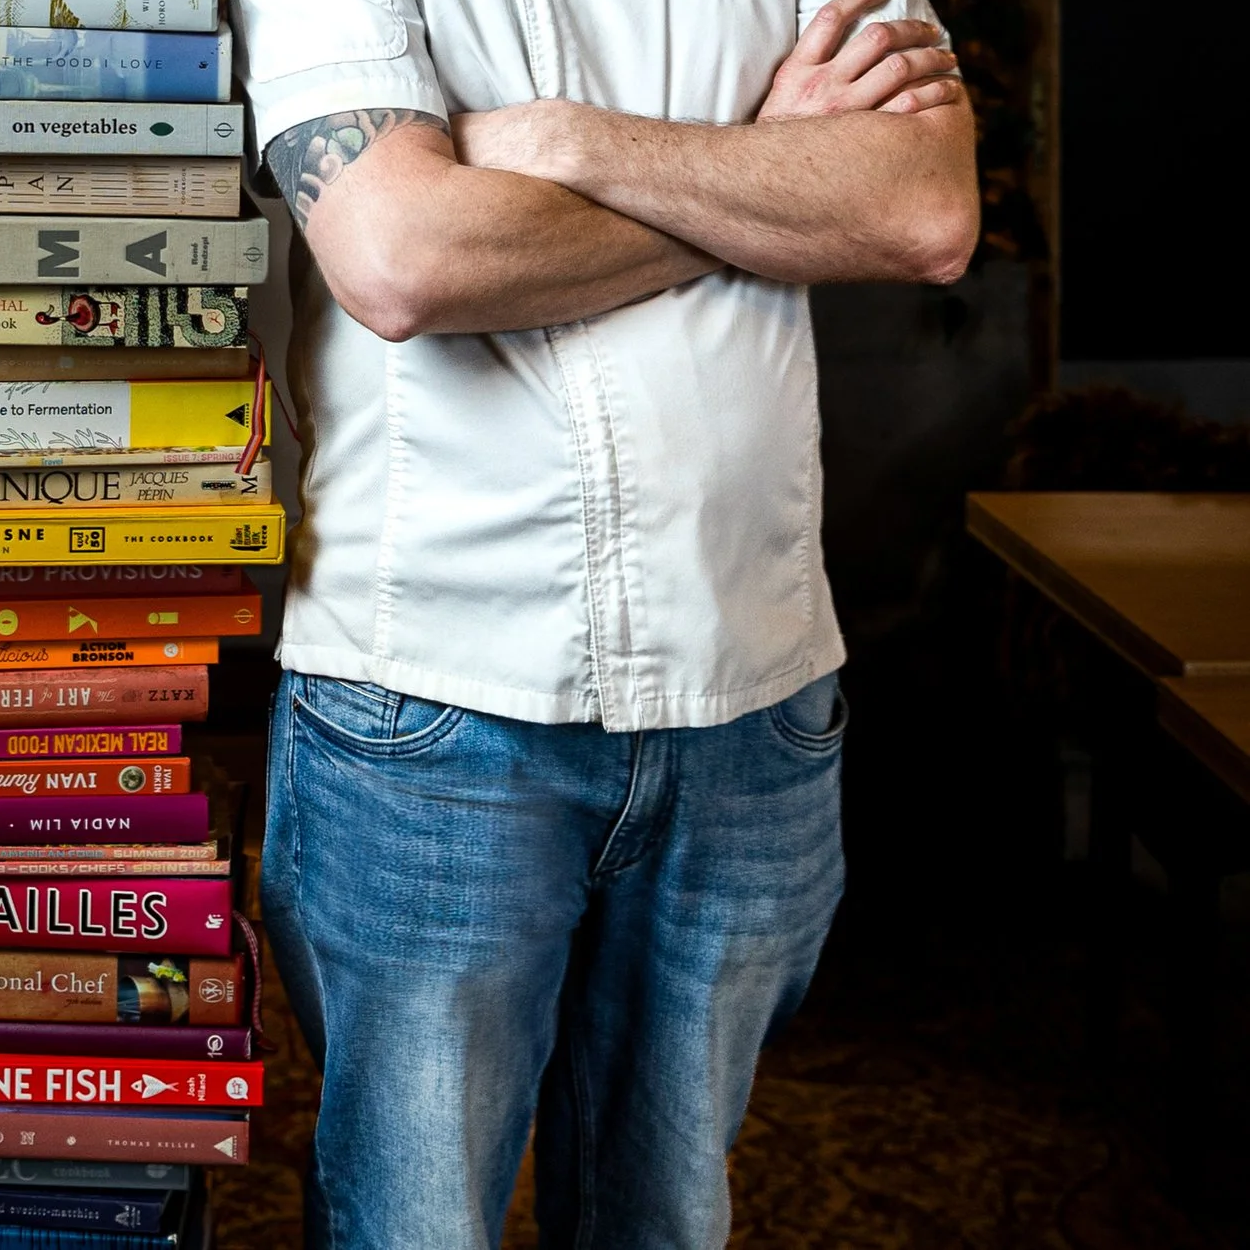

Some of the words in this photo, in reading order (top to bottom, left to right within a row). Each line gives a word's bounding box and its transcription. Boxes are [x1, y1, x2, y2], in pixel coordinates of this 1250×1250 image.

[2, 56, 33, 66] THE
[45, 57, 92, 68] FOOD
[104, 59, 108, 68] I
[120, 59, 162, 70] LOVE
[12, 120, 35, 133] on
[40, 118, 137, 138] vegetables
[201, 236, 210, 271] Redzepi
[11, 405, 24, 415] to
[29, 403, 112, 415] Fermentation
[41, 457, 63, 466] Travel
[163, 454, 190, 463] ISSUE
[201, 453, 234, 462] SPRING
[130, 471, 189, 487] JACQUES
[138, 487, 174, 501] PÉPIN
[44, 564, 203, 581] PROVISIONS
[80, 642, 126, 652] ACTION
[72, 652, 134, 662] BRONSON
[56, 688, 91, 706] ART
[148, 689, 196, 702] KATZ
[8, 735, 49, 755] FOOD
[54, 733, 123, 753] MEXICAN
[128, 731, 168, 752] REAL
[46, 772, 97, 789] IVAN
[153, 765, 162, 793] ORKIN
[163, 768, 172, 789] IVAN
[30, 819, 61, 830] LIM
[71, 817, 130, 830] NADIA
[113, 849, 174, 858] SUMMER
[180, 849, 208, 858] 2012
[132, 863, 188, 873] SPRING
[192, 863, 224, 872] 2012
[51, 972, 108, 994] Chef
[226, 979, 234, 1003] WILEY
[46, 1068, 122, 1102] FISH
[187, 1077, 196, 1097] Josh
[198, 1074, 206, 1101] Niland
[107, 1139, 150, 1147] THOMAS
[157, 1141, 196, 1149] KELLER
